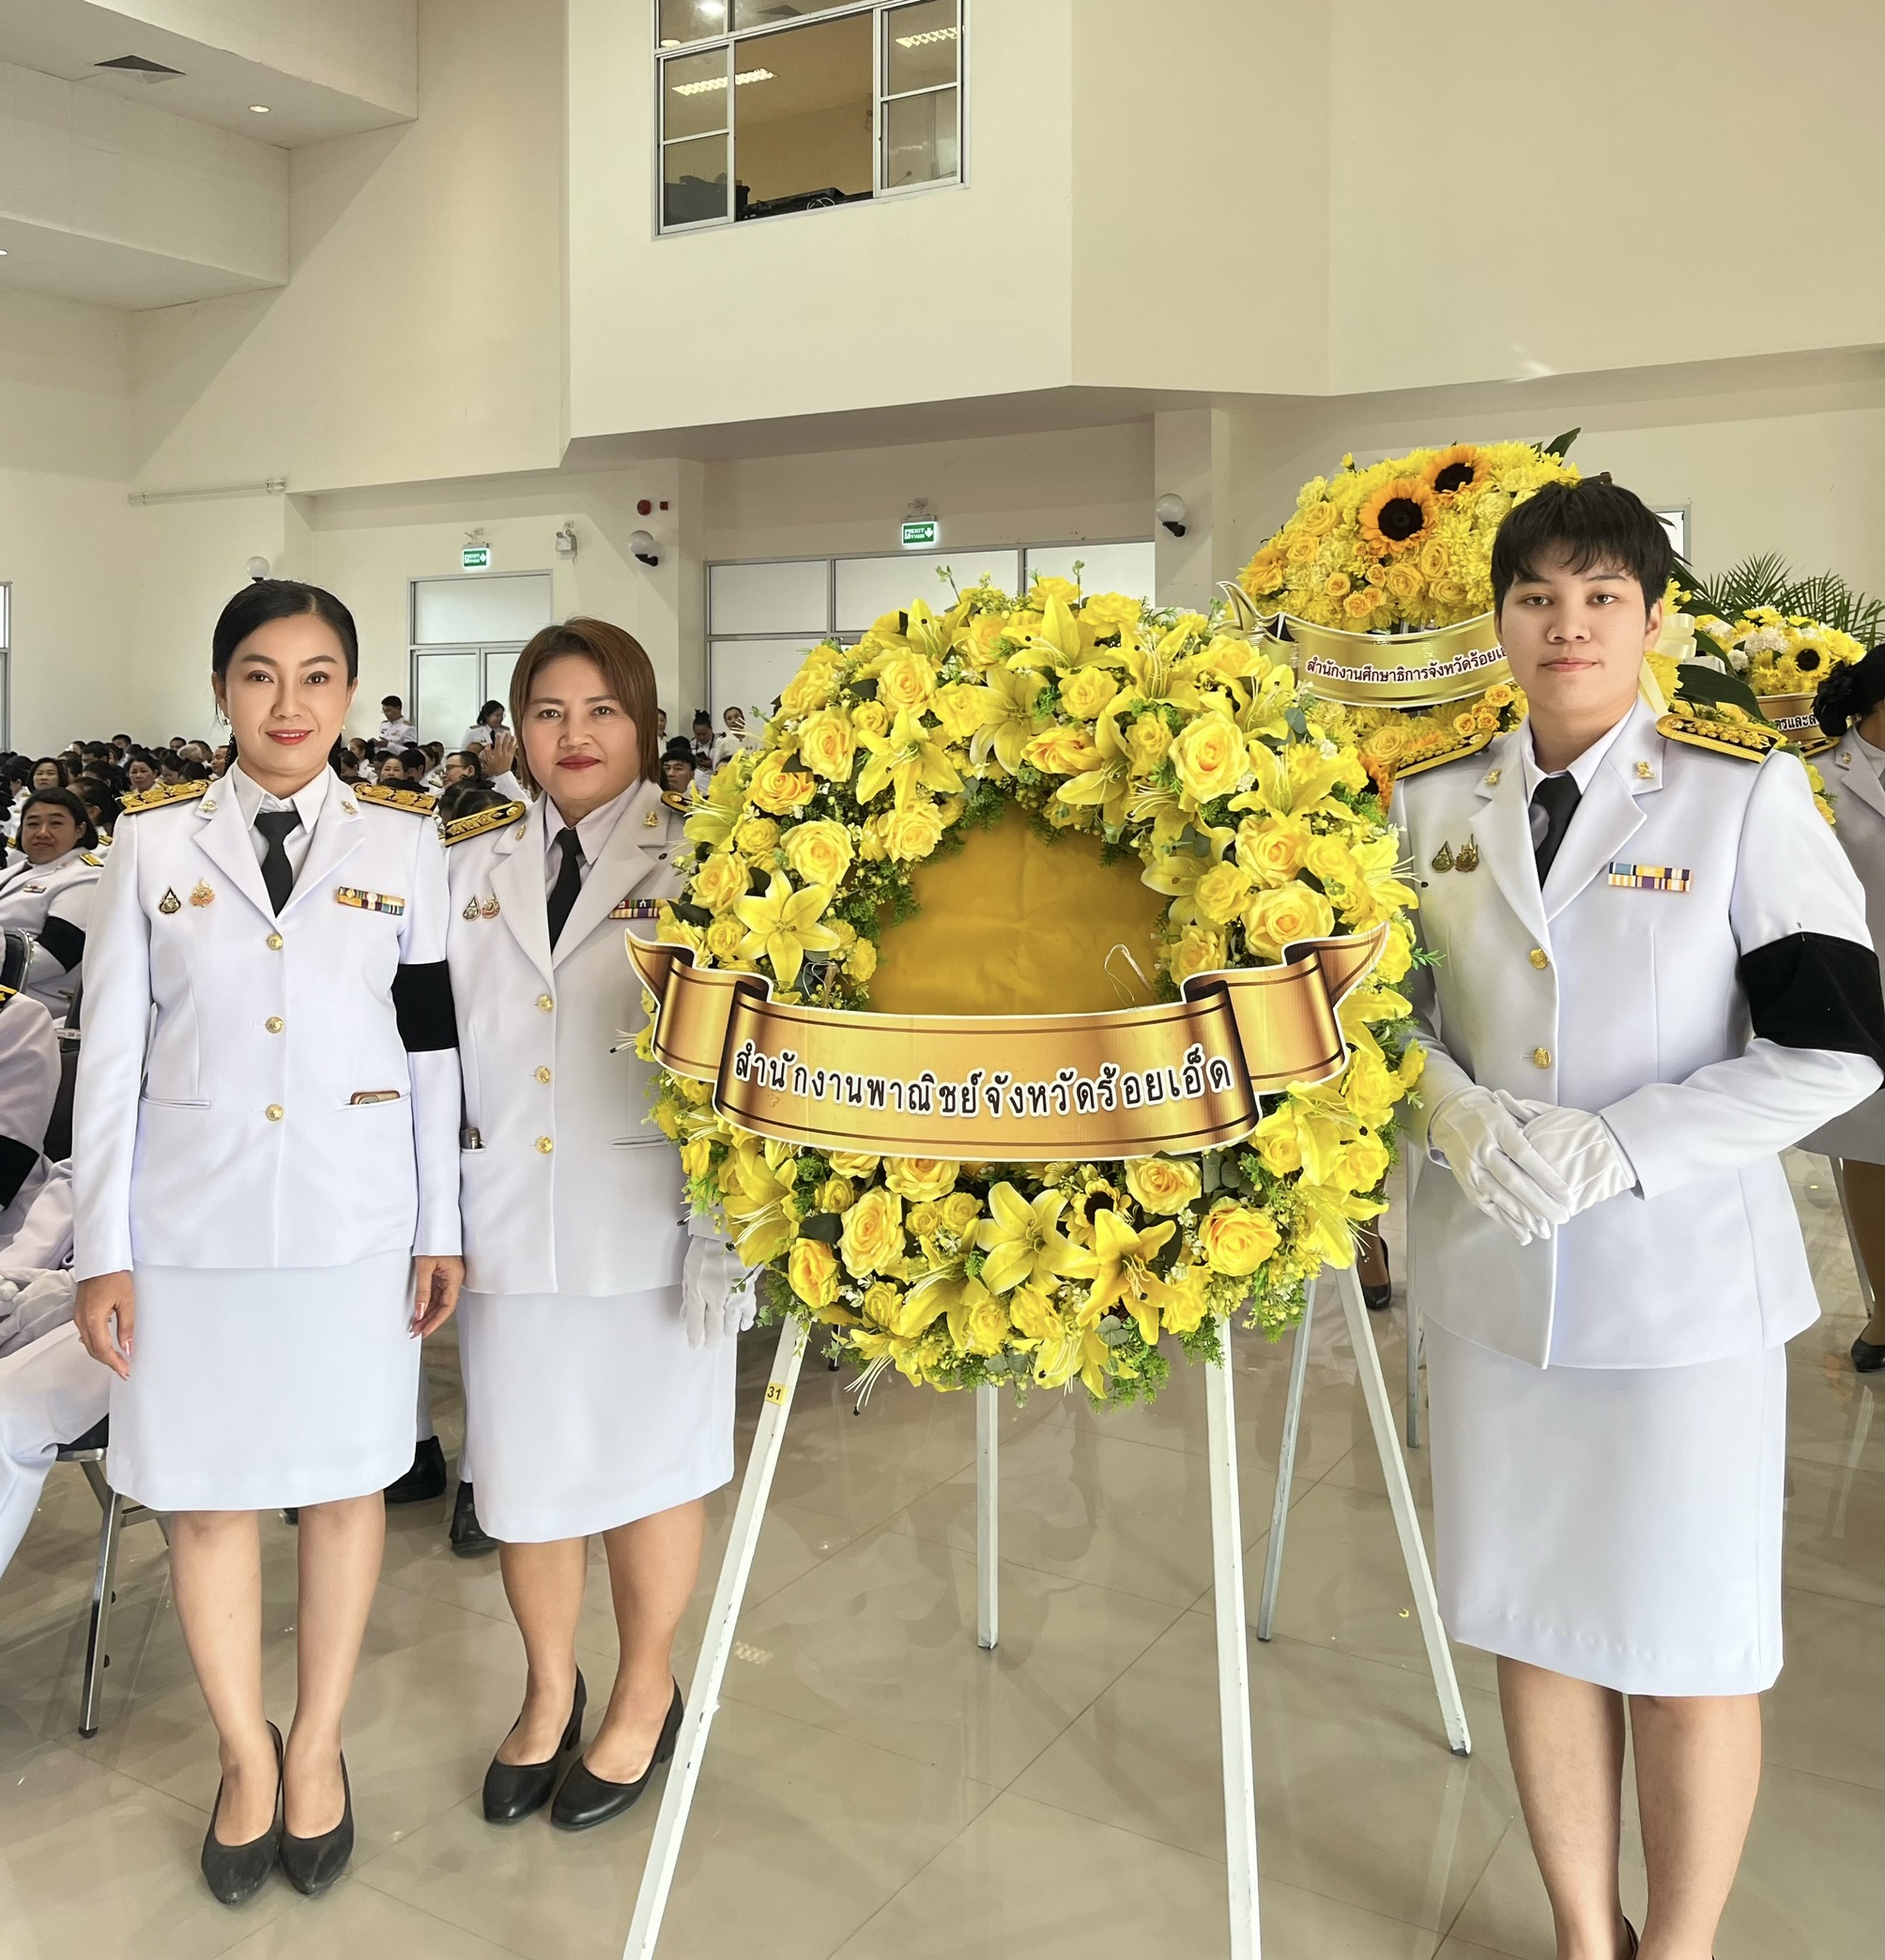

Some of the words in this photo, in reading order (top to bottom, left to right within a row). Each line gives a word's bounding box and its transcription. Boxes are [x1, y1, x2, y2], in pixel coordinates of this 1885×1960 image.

[735, 1042, 1231, 1114] สำนักงานพาณิชย์จังหวัดร้อยเอ็ด
[767, 1386, 781, 1400] 31
